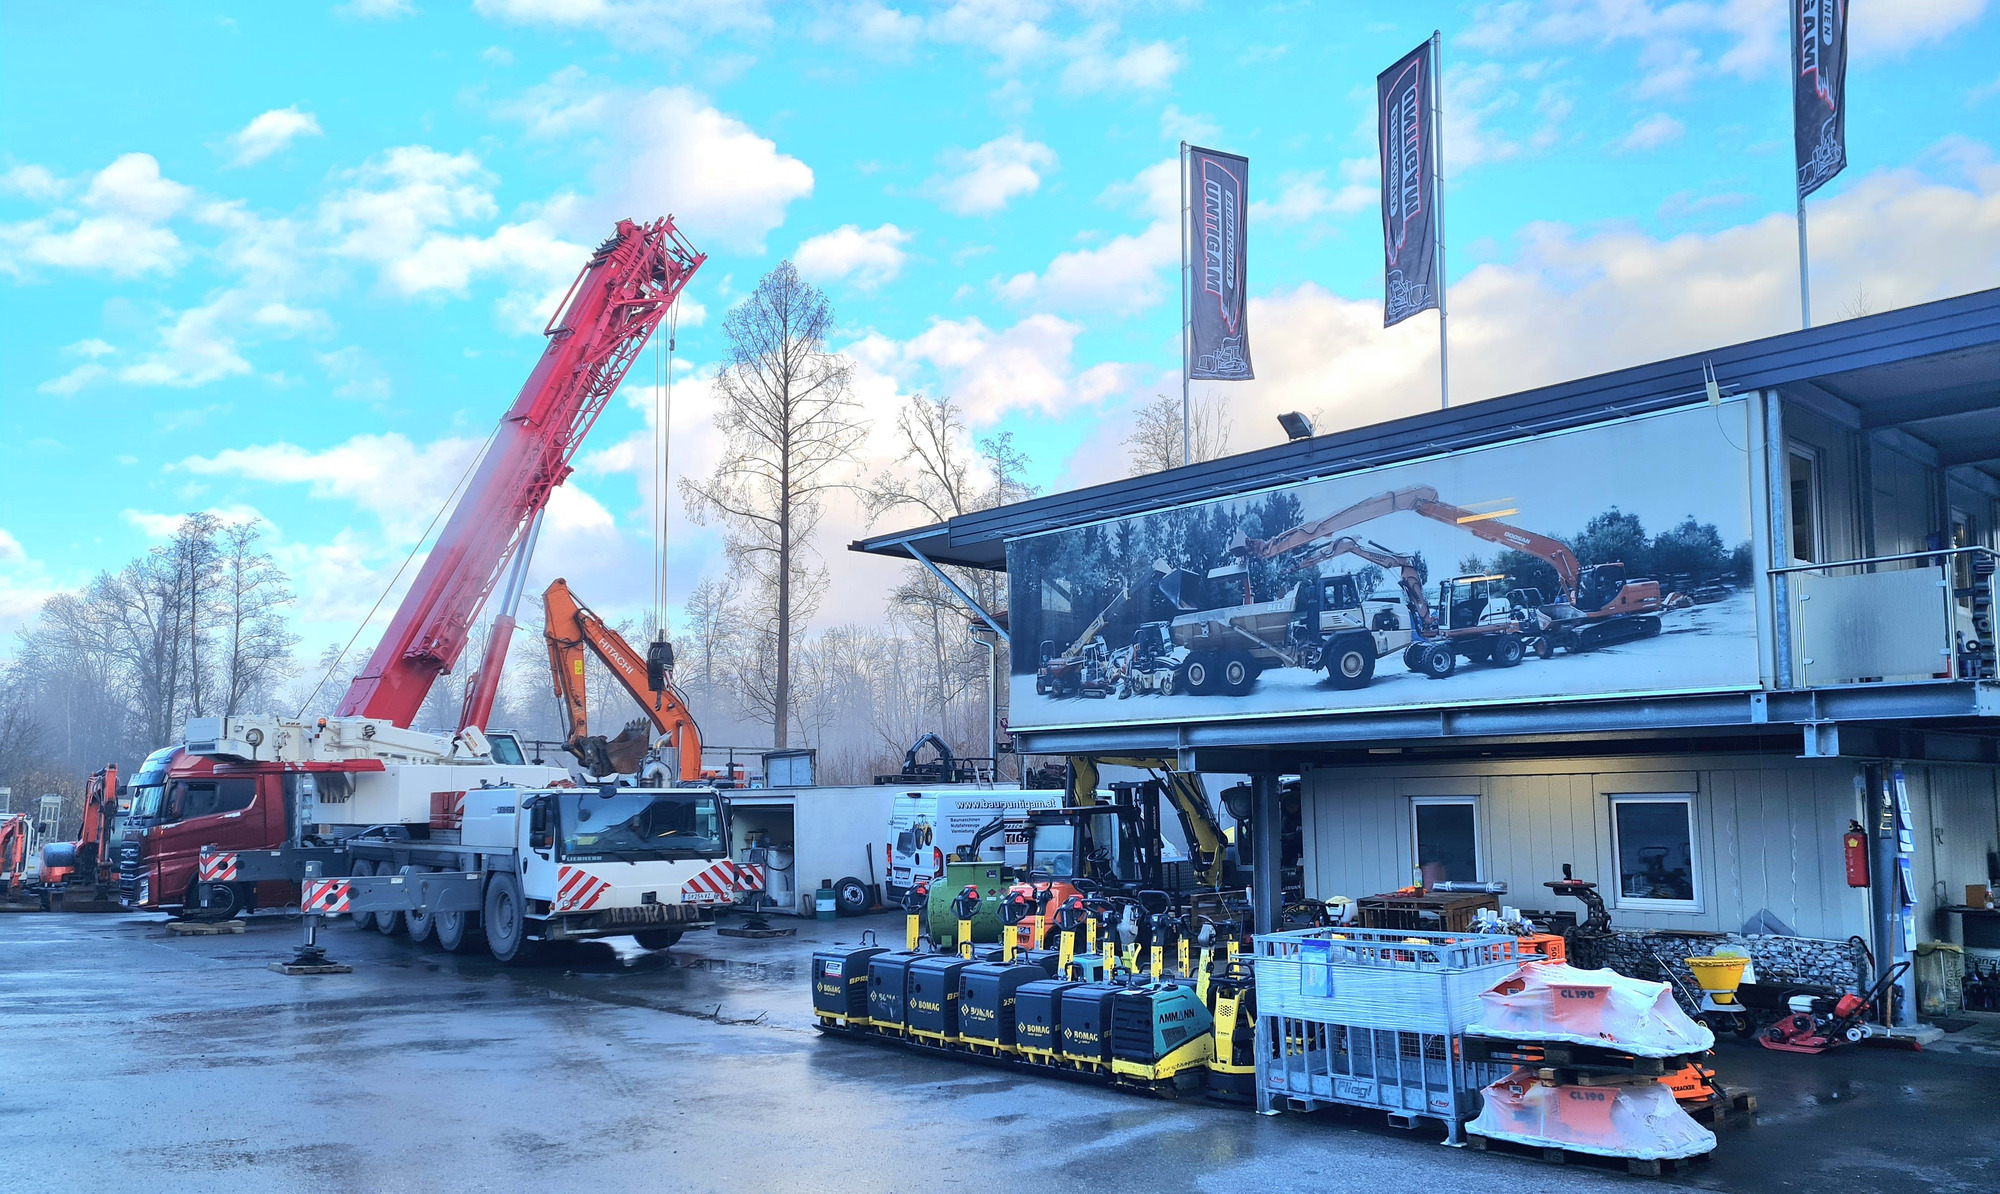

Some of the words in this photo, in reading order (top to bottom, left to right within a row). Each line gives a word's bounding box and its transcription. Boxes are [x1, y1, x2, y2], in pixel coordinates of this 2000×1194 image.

[1226, 194, 1234, 284] BAUMASCHINEN
[1266, 603, 1286, 611] BELL
[598, 637, 635, 675] HITACHI
[954, 798, 1057, 810] www.baupuntigam.at
[918, 1000, 940, 1012] BOMAG
[1158, 1008, 1195, 1024] AMMANN
[1026, 1024, 1050, 1035] BOMAG
[1073, 1030, 1099, 1042] BOMAG
